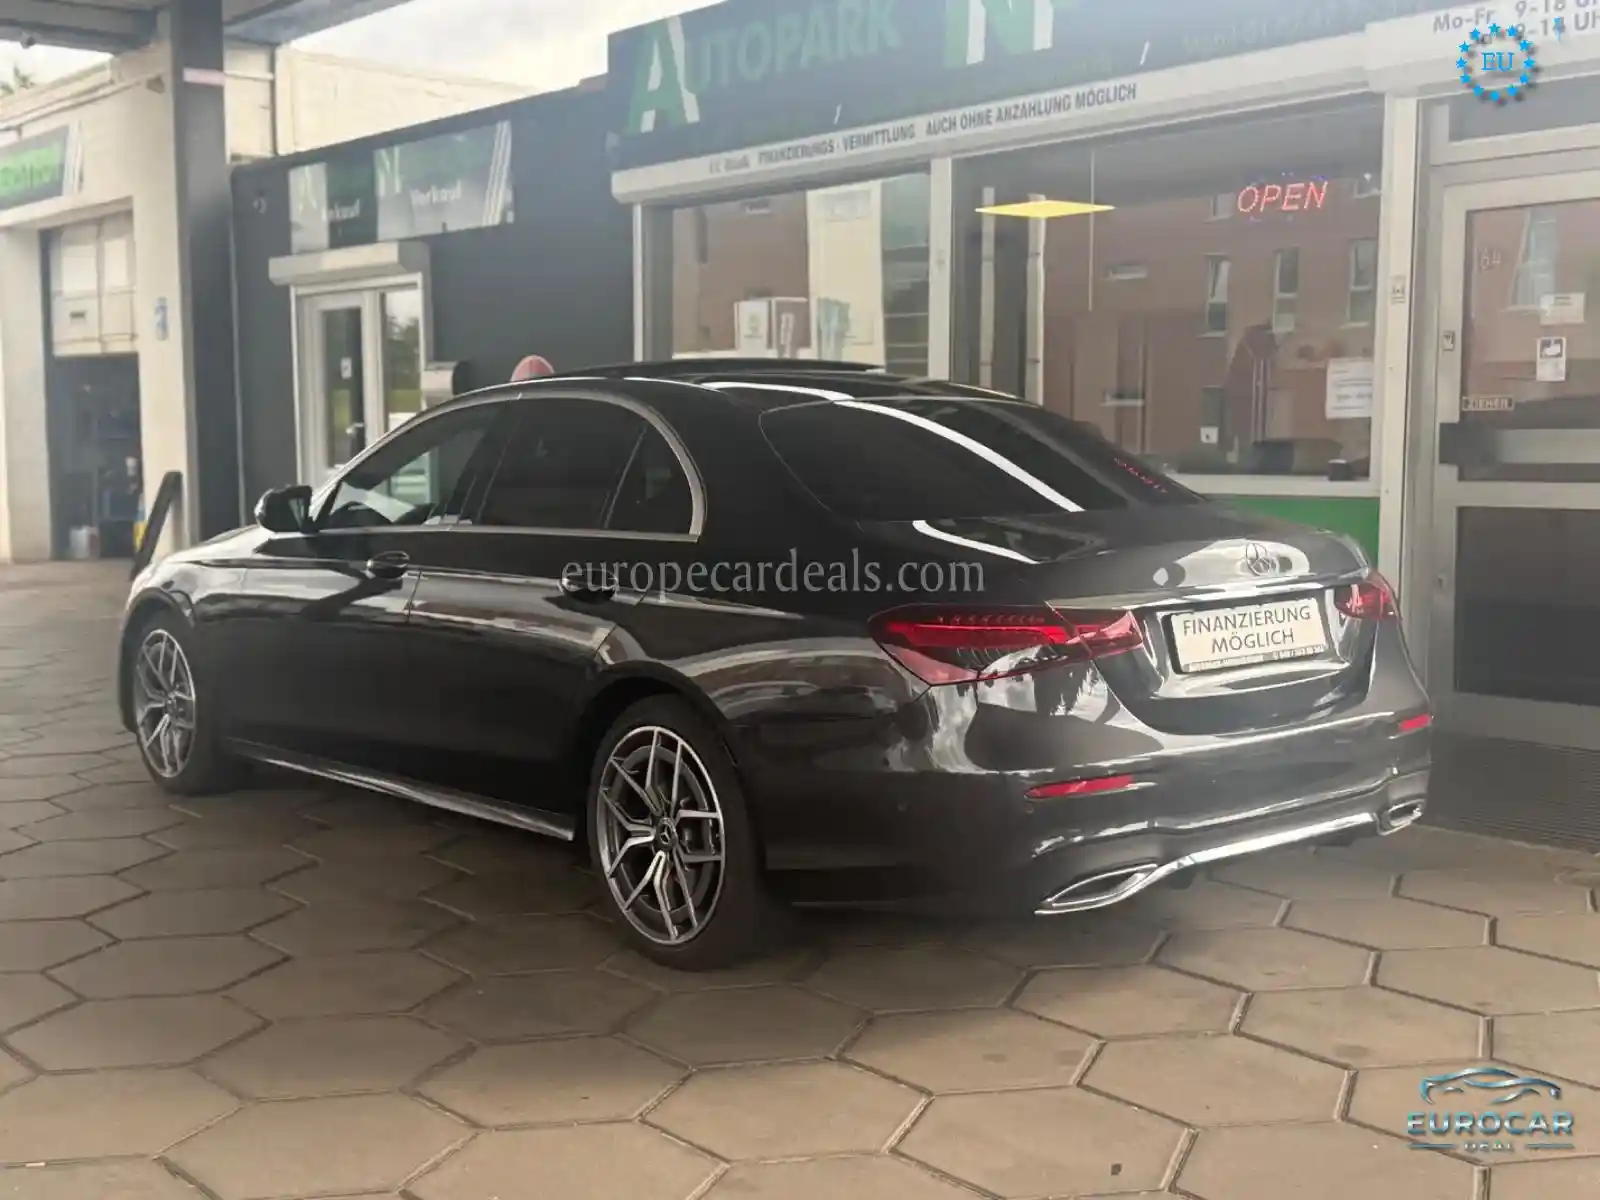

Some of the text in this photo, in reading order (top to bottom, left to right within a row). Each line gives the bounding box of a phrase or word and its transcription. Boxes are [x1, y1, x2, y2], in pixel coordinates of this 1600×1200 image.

[1433, 7, 1497, 34] Mo-Fr
[926, 117, 958, 137] AUCH
[959, 109, 993, 130] OHNE
[995, 95, 1072, 123] ANZAHLUNG
[1237, 180, 1329, 214] OPEN
[1183, 604, 1312, 637] FINANZIERUNG
[1211, 628, 1295, 655] MÖGLICH
